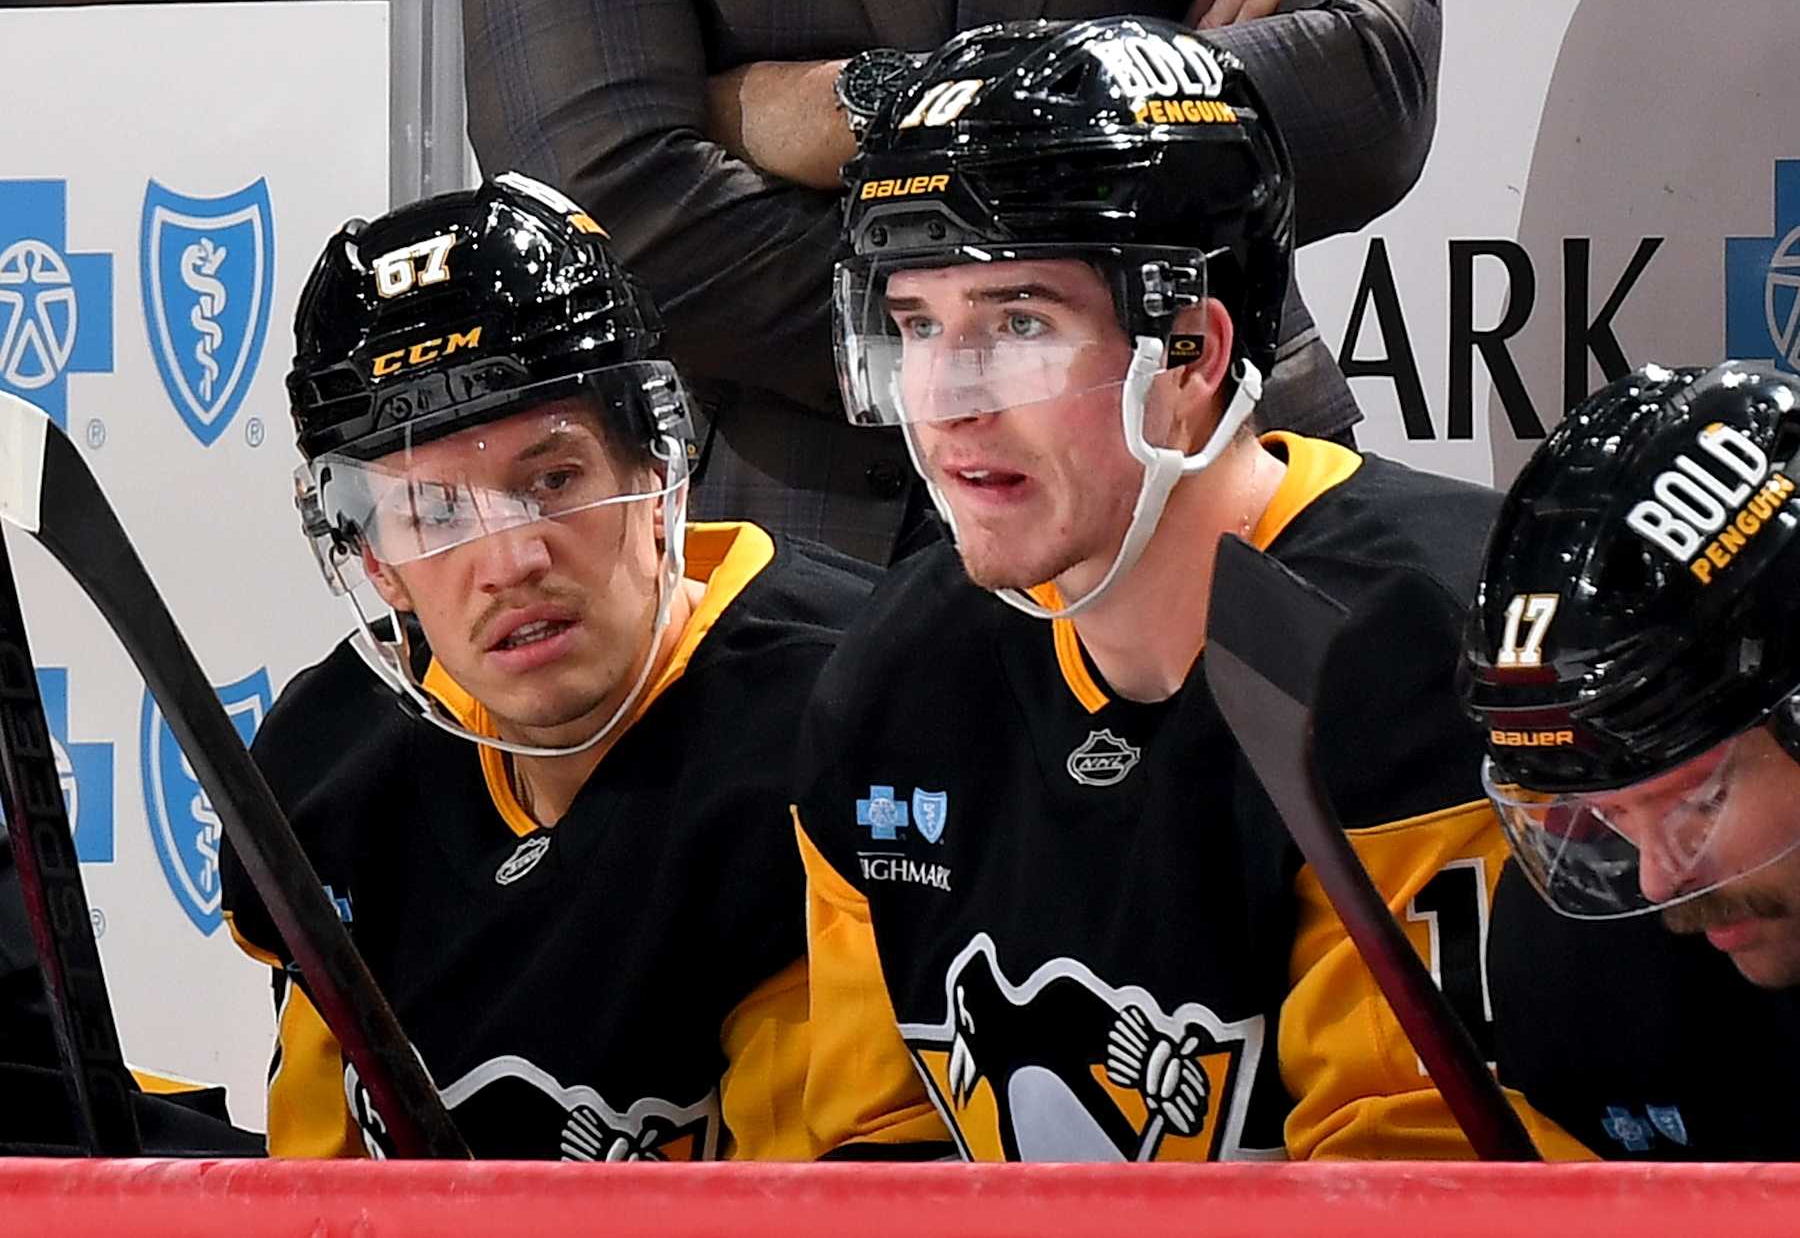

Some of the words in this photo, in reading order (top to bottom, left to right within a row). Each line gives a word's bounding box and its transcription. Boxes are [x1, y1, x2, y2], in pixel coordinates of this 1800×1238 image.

[1086, 34, 1224, 98] BOLD
[898, 79, 985, 130] 10
[1134, 99, 1238, 125] PENGUIN
[371, 232, 457, 299] 67
[371, 326, 484, 377] CCM
[1337, 237, 1665, 441] ARK
[1626, 422, 1769, 562] BOLD
[1690, 473, 1797, 585] PENGUIN
[1496, 593, 1560, 668] 17
[859, 857, 952, 892] IGHMARK
